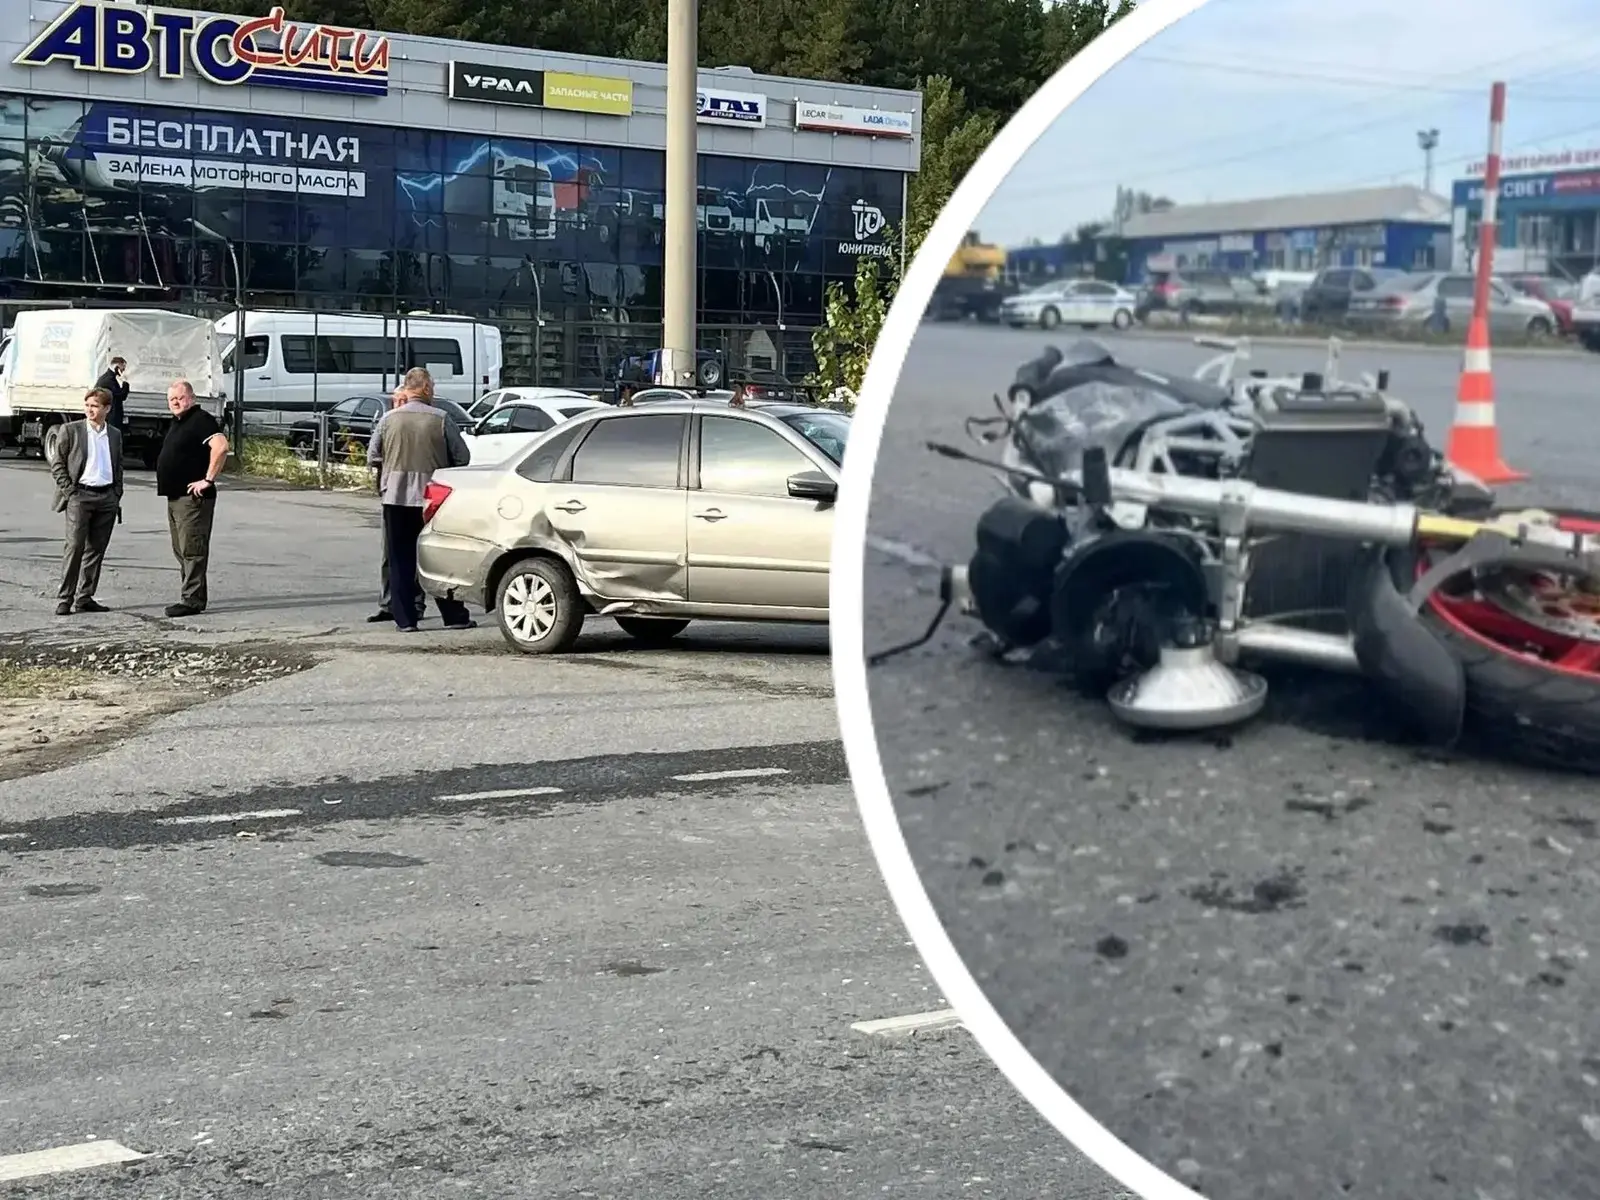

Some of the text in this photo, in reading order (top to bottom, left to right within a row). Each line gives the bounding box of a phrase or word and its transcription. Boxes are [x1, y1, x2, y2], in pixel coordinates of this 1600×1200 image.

[463, 74, 534, 94] УРАЛ
[549, 86, 629, 103] ЗАПАСНЫЕ ЧАСТИ
[710, 97, 759, 114] ГАЗ
[802, 109, 826, 119] LECAR
[863, 115, 884, 125] LADA
[106, 115, 361, 164] БЕСПЛАТНАЯ
[108, 159, 359, 191] ЗАМЕНА МОТОРНОГО МАСЛА
[838, 242, 892, 257] ЮНИТРЕЙД
